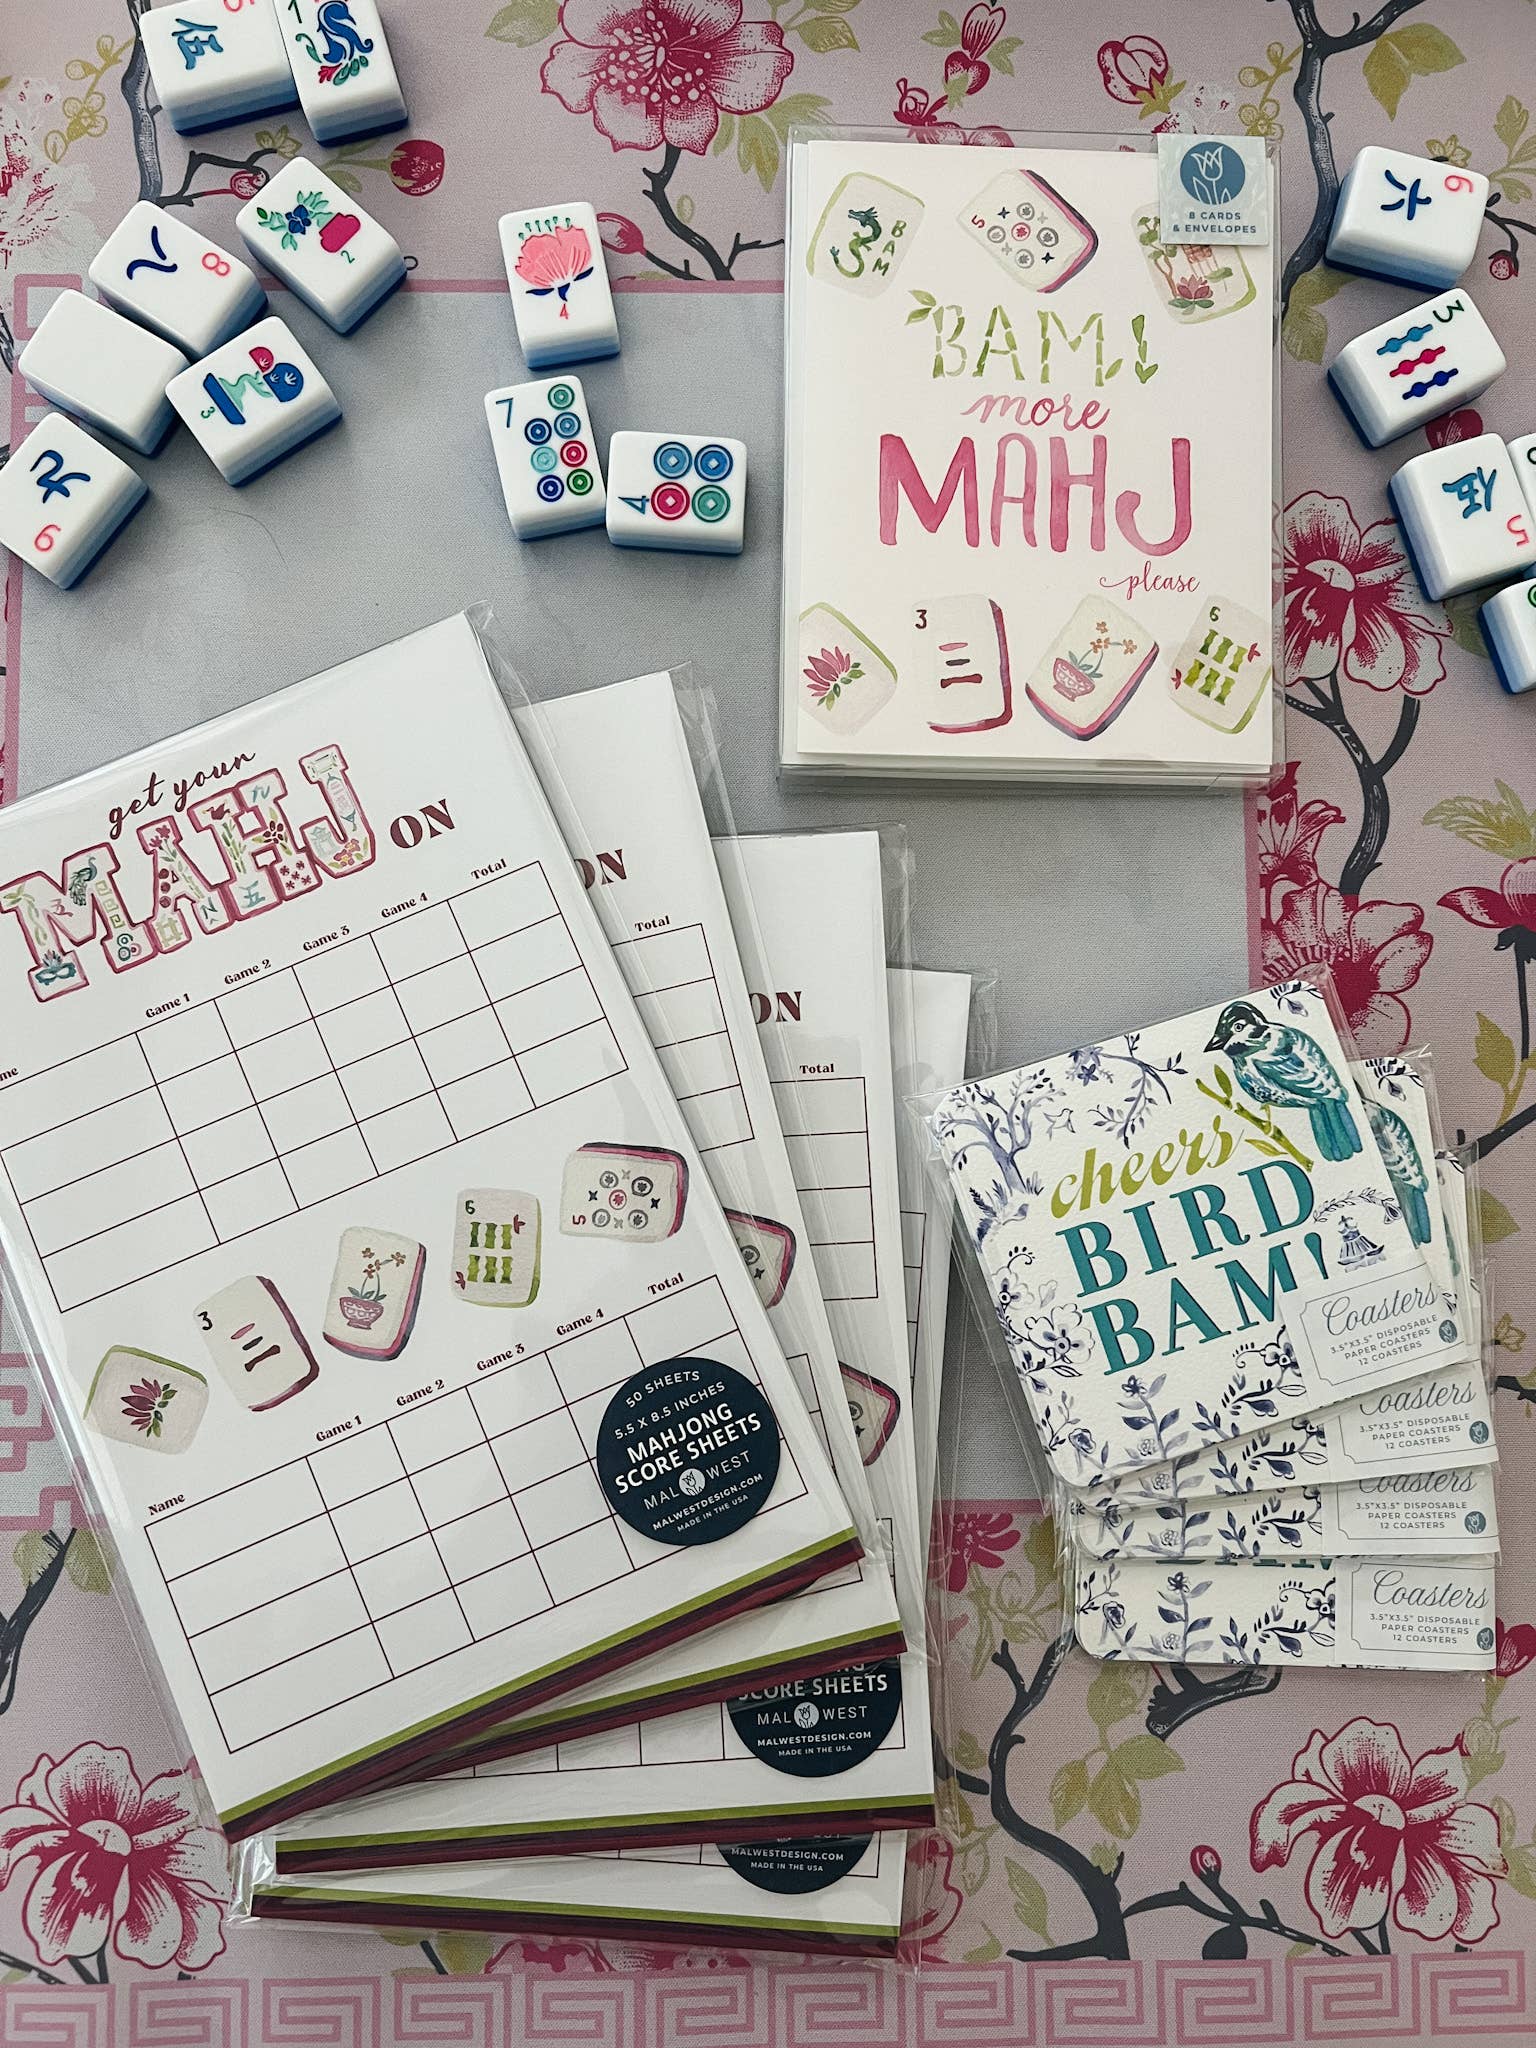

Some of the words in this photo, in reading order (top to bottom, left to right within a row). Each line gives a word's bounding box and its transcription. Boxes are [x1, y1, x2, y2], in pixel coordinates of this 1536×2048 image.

[970, 214, 986, 229] 5
[1188, 211, 1196, 220] 8
[1200, 211, 1241, 220] CARDS
[1173, 224, 1180, 232] &
[1185, 224, 1257, 233] ENVELOPES
[201, 252, 231, 277] 8
[559, 303, 569, 320] 4
[1432, 299, 1465, 323] 3
[931, 303, 1159, 387] BAM!
[495, 397, 514, 428] 7
[960, 392, 1110, 432] more
[617, 494, 650, 515] 4
[878, 432, 1192, 557] MAHJ
[1506, 514, 1530, 547] 5
[1099, 560, 1200, 601] please
[915, 609, 928, 629] 3
[1208, 606, 1220, 622] 6
[109, 772, 166, 839] get
[173, 752, 256, 813] your
[0, 743, 377, 1003] MAHJ
[389, 798, 455, 849] ON
[634, 915, 670, 932] Total
[145, 1000, 180, 1019] Game
[182, 993, 191, 1004] 1
[224, 966, 259, 985] Game
[262, 958, 272, 971] 2
[302, 932, 338, 952] Game
[340, 925, 351, 936] 3
[380, 898, 417, 918] Game
[419, 892, 428, 903] 4
[470, 858, 508, 880] Total
[799, 1063, 835, 1074] Total
[1050, 1114, 1245, 1219] cheers
[465, 1200, 476, 1215] 6
[572, 1214, 587, 1225] 5
[1055, 1160, 1315, 1298] BIRD
[1322, 1282, 1438, 1336] Coasters
[197, 1311, 213, 1331] 3
[1376, 1314, 1438, 1339] DISPOSABLE
[1345, 1344, 1377, 1360] PAPER
[1380, 1327, 1431, 1350] COASTERS
[1359, 1357, 1369, 1366] 12
[1371, 1341, 1422, 1362] COASTERS
[148, 1493, 186, 1516] Name
[315, 1421, 352, 1442] Game
[354, 1415, 363, 1427] 1
[397, 1386, 433, 1406] Game
[435, 1378, 445, 1391] 2
[476, 1351, 513, 1372] Game
[515, 1343, 525, 1355] 3
[556, 1316, 593, 1337] Game
[595, 1308, 604, 1320] 4
[647, 1272, 685, 1296] Total
[626, 1391, 643, 1408] 50
[644, 1370, 700, 1394] SHEETS
[614, 1423, 635, 1440] 5.5
[638, 1417, 648, 1429] X
[650, 1406, 672, 1423] 8.5
[674, 1381, 726, 1412] INCHES
[1407, 1413, 1470, 1427] DISPOSABLE
[627, 1403, 733, 1464] MAHJONG
[1372, 1431, 1405, 1441] PAPER
[1408, 1424, 1461, 1438] COASTERS
[1385, 1441, 1395, 1450] 12
[1398, 1435, 1451, 1448] COASTERS
[615, 1449, 684, 1494] SCORE
[686, 1413, 762, 1460] SHEETS
[643, 1486, 680, 1510] MAL
[706, 1450, 750, 1480] WEST
[652, 1473, 763, 1530] MALWESTDESIGN.COM
[1403, 1501, 1468, 1509] DISPOSABLE
[676, 1517, 701, 1532] MADE
[702, 1510, 713, 1520] IN
[714, 1502, 730, 1515] THE
[731, 1494, 749, 1507] USA
[1404, 1511, 1457, 1519] COASTERS
[1393, 1521, 1446, 1529] COASTERS
[1373, 1569, 1489, 1609] Coasters
[1381, 1624, 1414, 1632] PAPER
[1417, 1625, 1469, 1635] COASTERS
[1417, 1615, 1480, 1626] DISPOSABLE
[1406, 1634, 1458, 1644] COASTERS
[812, 1674, 888, 1696] SHEETS
[757, 1712, 792, 1725] MAL
[822, 1705, 868, 1720] WEST
[757, 1730, 872, 1747] MALWESTDESIGN.COM
[778, 1749, 802, 1757] MADE
[817, 1746, 833, 1754] THE
[731, 1847, 844, 1861] MALWESTDESIGN.COM
[750, 1862, 774, 1870] MADE
